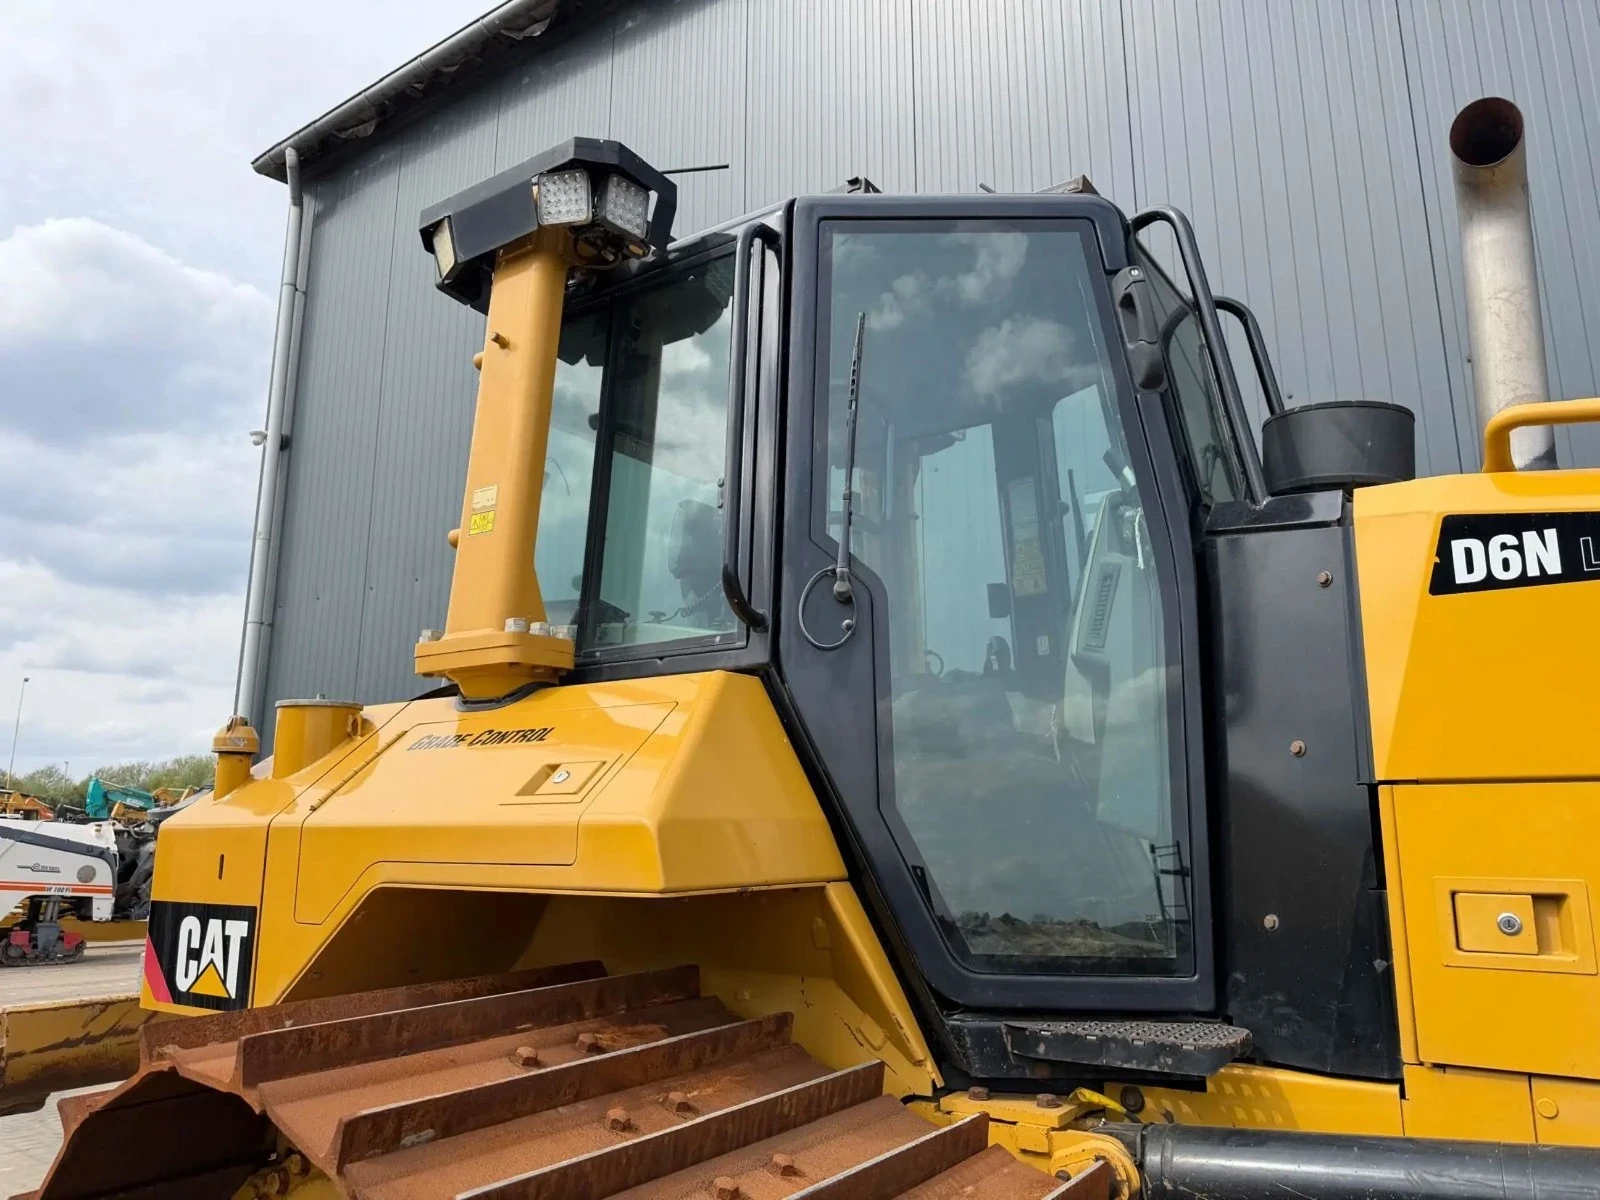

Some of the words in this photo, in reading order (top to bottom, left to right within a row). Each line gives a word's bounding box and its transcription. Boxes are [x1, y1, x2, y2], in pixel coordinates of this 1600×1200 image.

[1450, 528, 1562, 585] D6N
[406, 733, 474, 752] GRADE
[467, 726, 555, 747] CONTROL
[175, 915, 249, 1000] CAT
